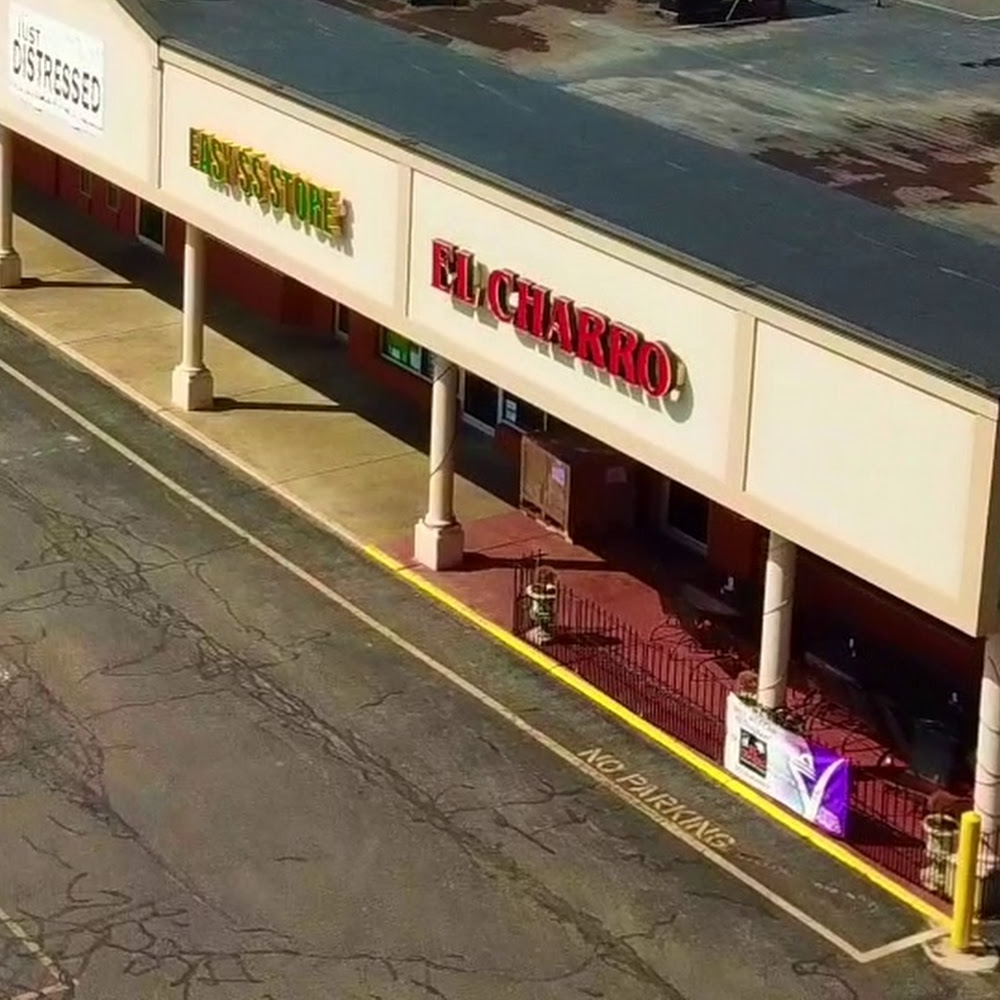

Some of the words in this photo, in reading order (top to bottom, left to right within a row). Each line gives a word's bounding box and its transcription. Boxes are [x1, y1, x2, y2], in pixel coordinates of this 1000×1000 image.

[12, 38, 101, 114] DISTRESSED
[430, 238, 480, 308] EL
[486, 267, 673, 398] CHARRO
[577, 747, 627, 774] NO
[616, 773, 736, 848] PARKING
